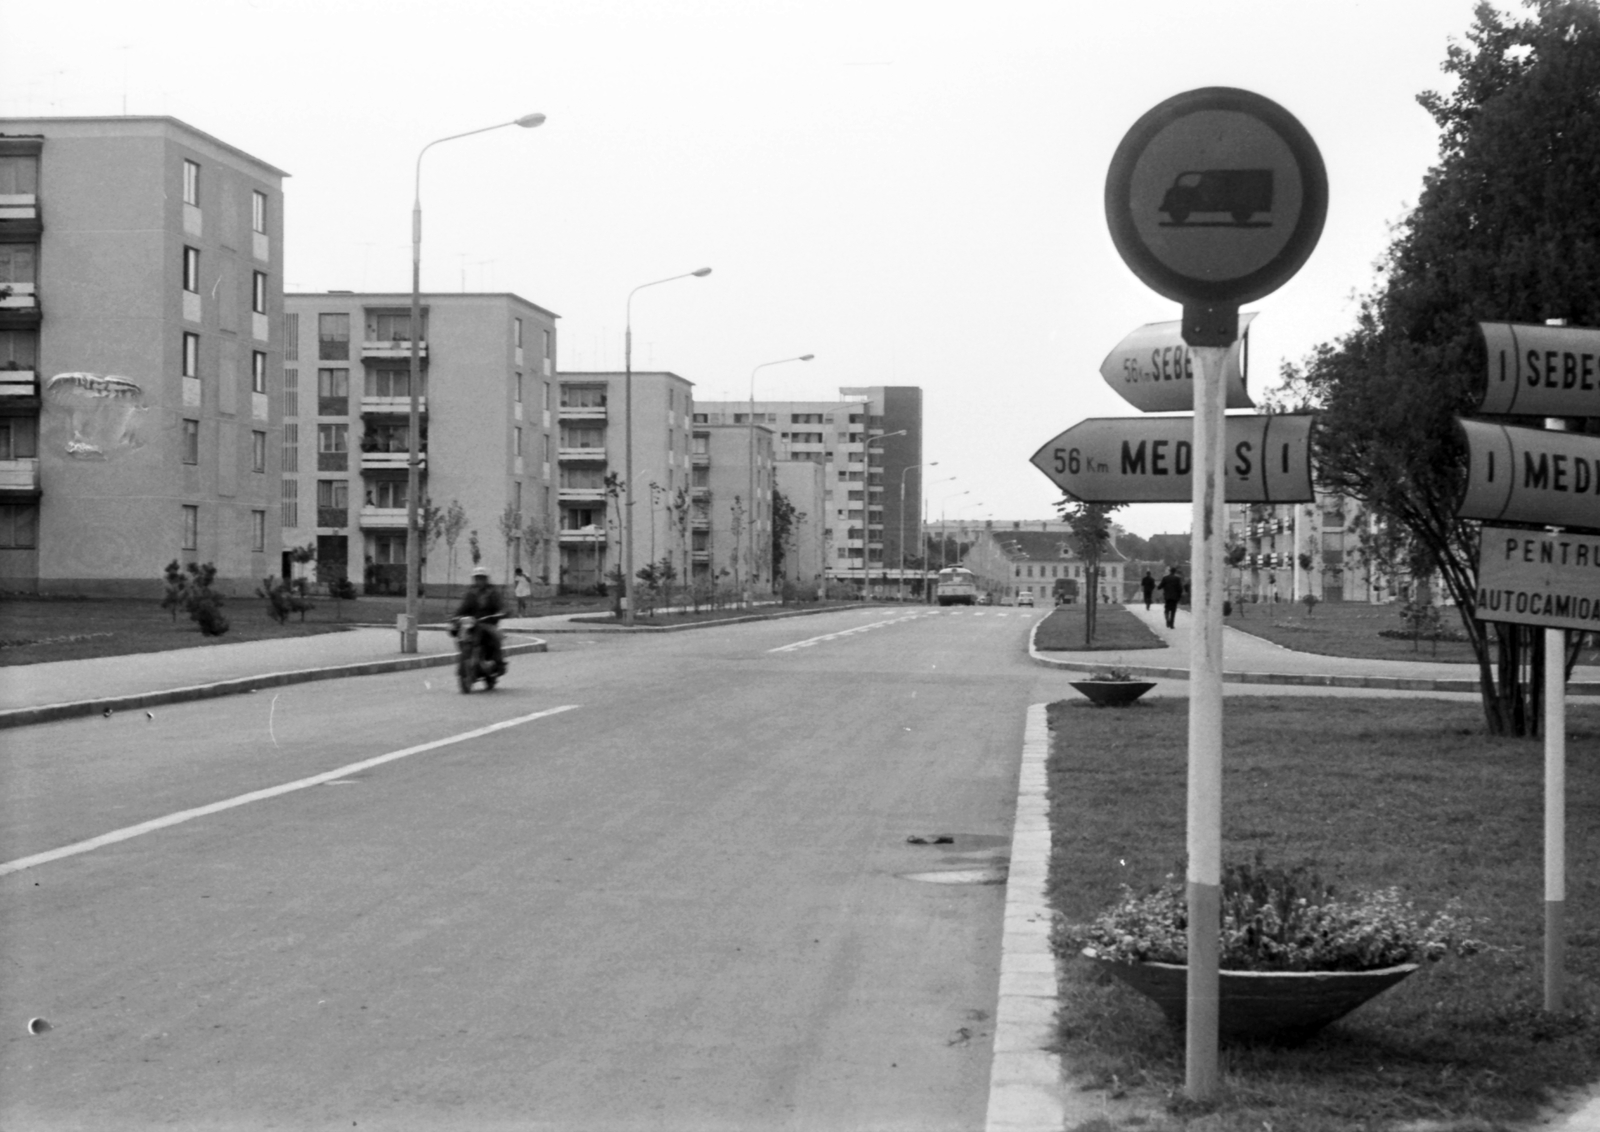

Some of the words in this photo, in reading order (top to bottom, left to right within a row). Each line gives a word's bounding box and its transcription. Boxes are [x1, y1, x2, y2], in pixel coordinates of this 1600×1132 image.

[1124, 358, 1138, 383] 56
[1500, 350, 1506, 382] I
[1527, 350, 1600, 390] SEBE
[1053, 448, 1080, 475] 56
[1086, 457, 1109, 473] Km
[1121, 440, 1252, 481] MEDȘ
[1282, 443, 1289, 474] I
